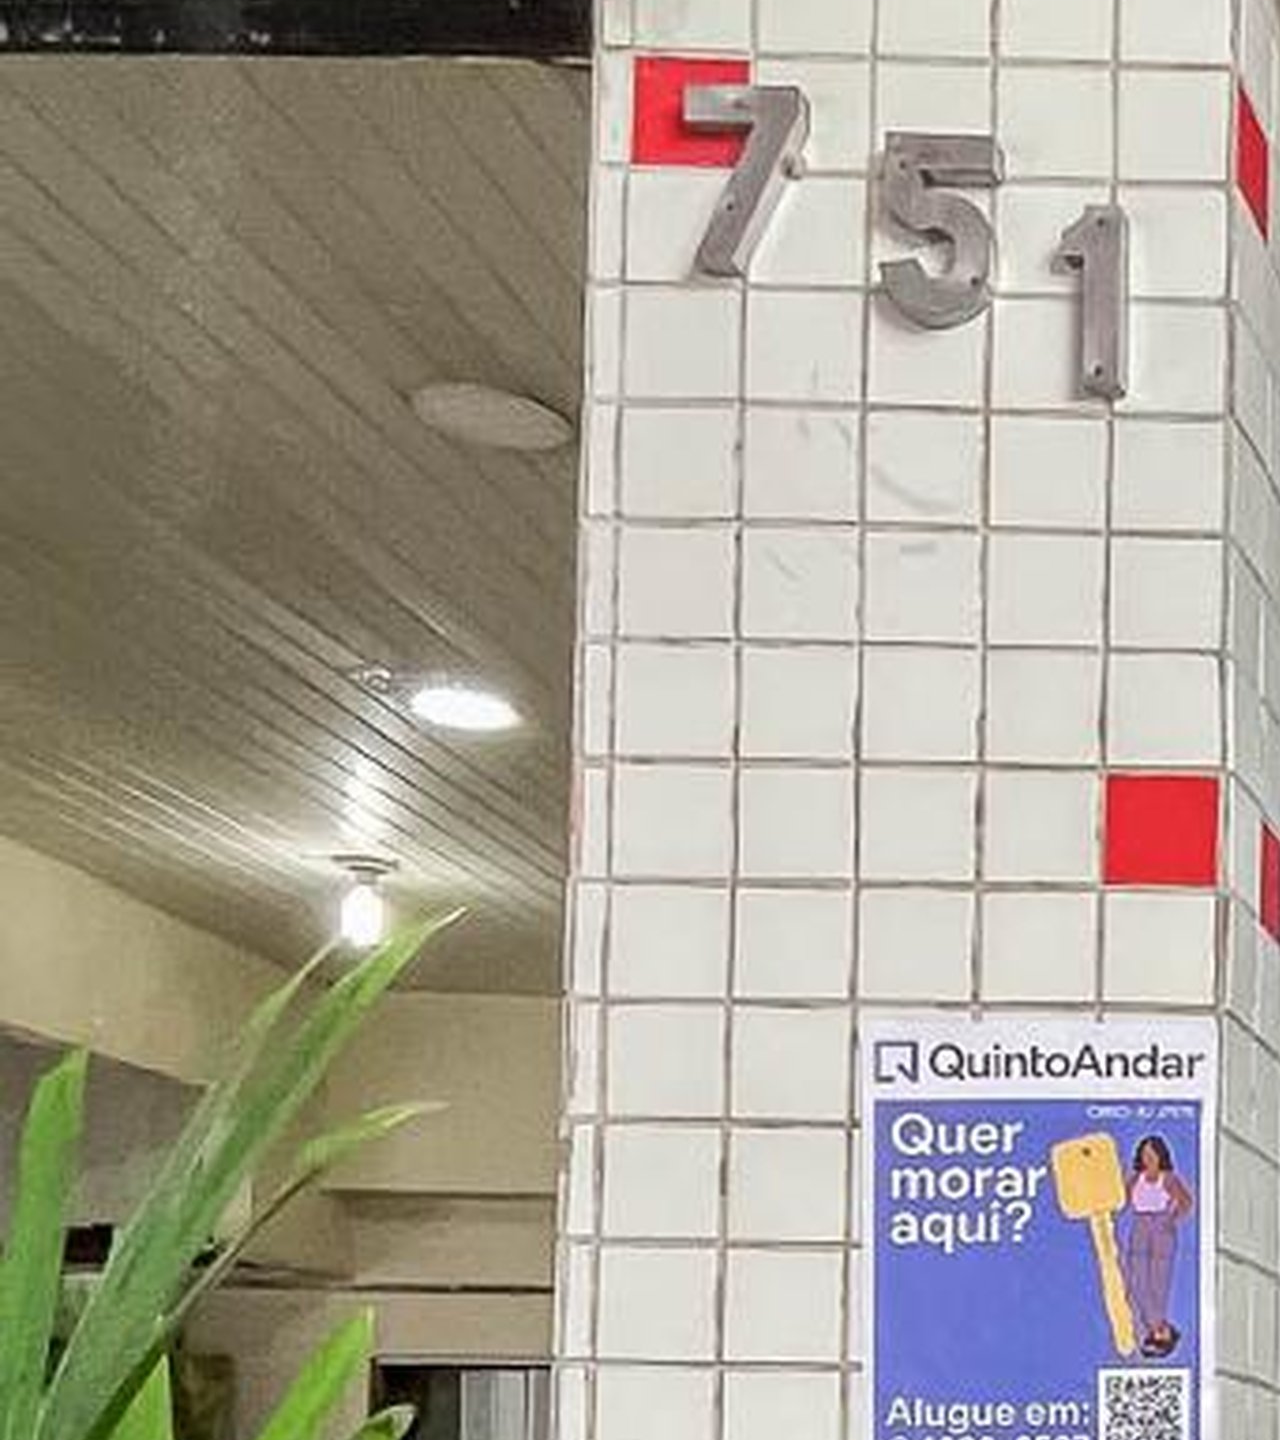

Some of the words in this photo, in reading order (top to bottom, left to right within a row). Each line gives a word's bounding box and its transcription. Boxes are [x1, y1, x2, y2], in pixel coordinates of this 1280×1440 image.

[681, 85, 1130, 400] 751
[929, 1042, 1206, 1081] QuintoAndar
[890, 1112, 1024, 1156] Quer
[890, 1166, 1047, 1200] morar
[886, 1397, 1016, 1433] Alugue
[1026, 1401, 1090, 1426] em:
